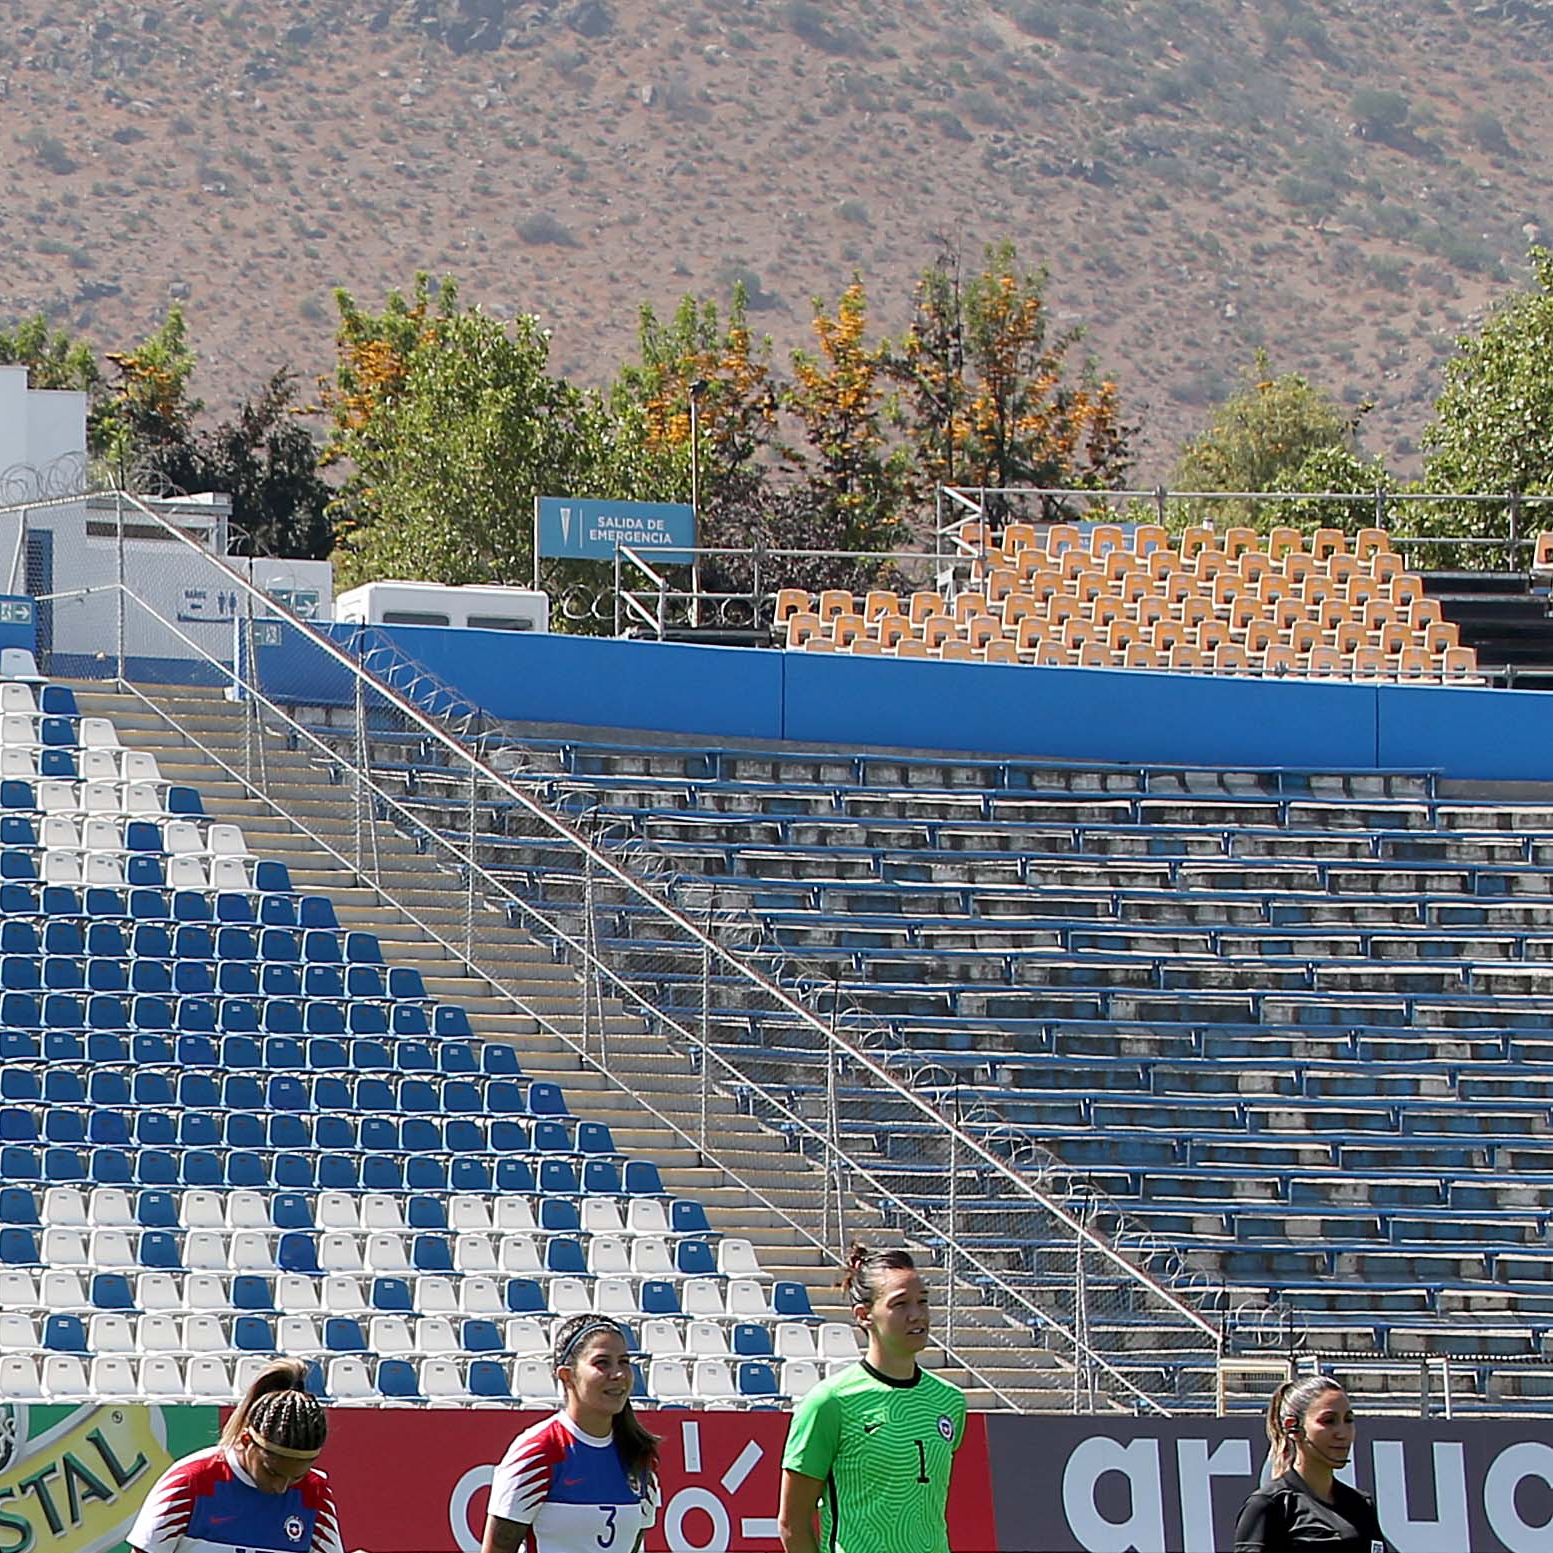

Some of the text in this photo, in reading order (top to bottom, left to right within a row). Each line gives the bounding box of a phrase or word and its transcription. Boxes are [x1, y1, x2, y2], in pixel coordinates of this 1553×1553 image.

[589, 530, 672, 544] EMERGENCIA
[597, 516, 664, 530] SALIDA DE
[914, 1439, 930, 1484] 1
[596, 1505, 617, 1549] 3
